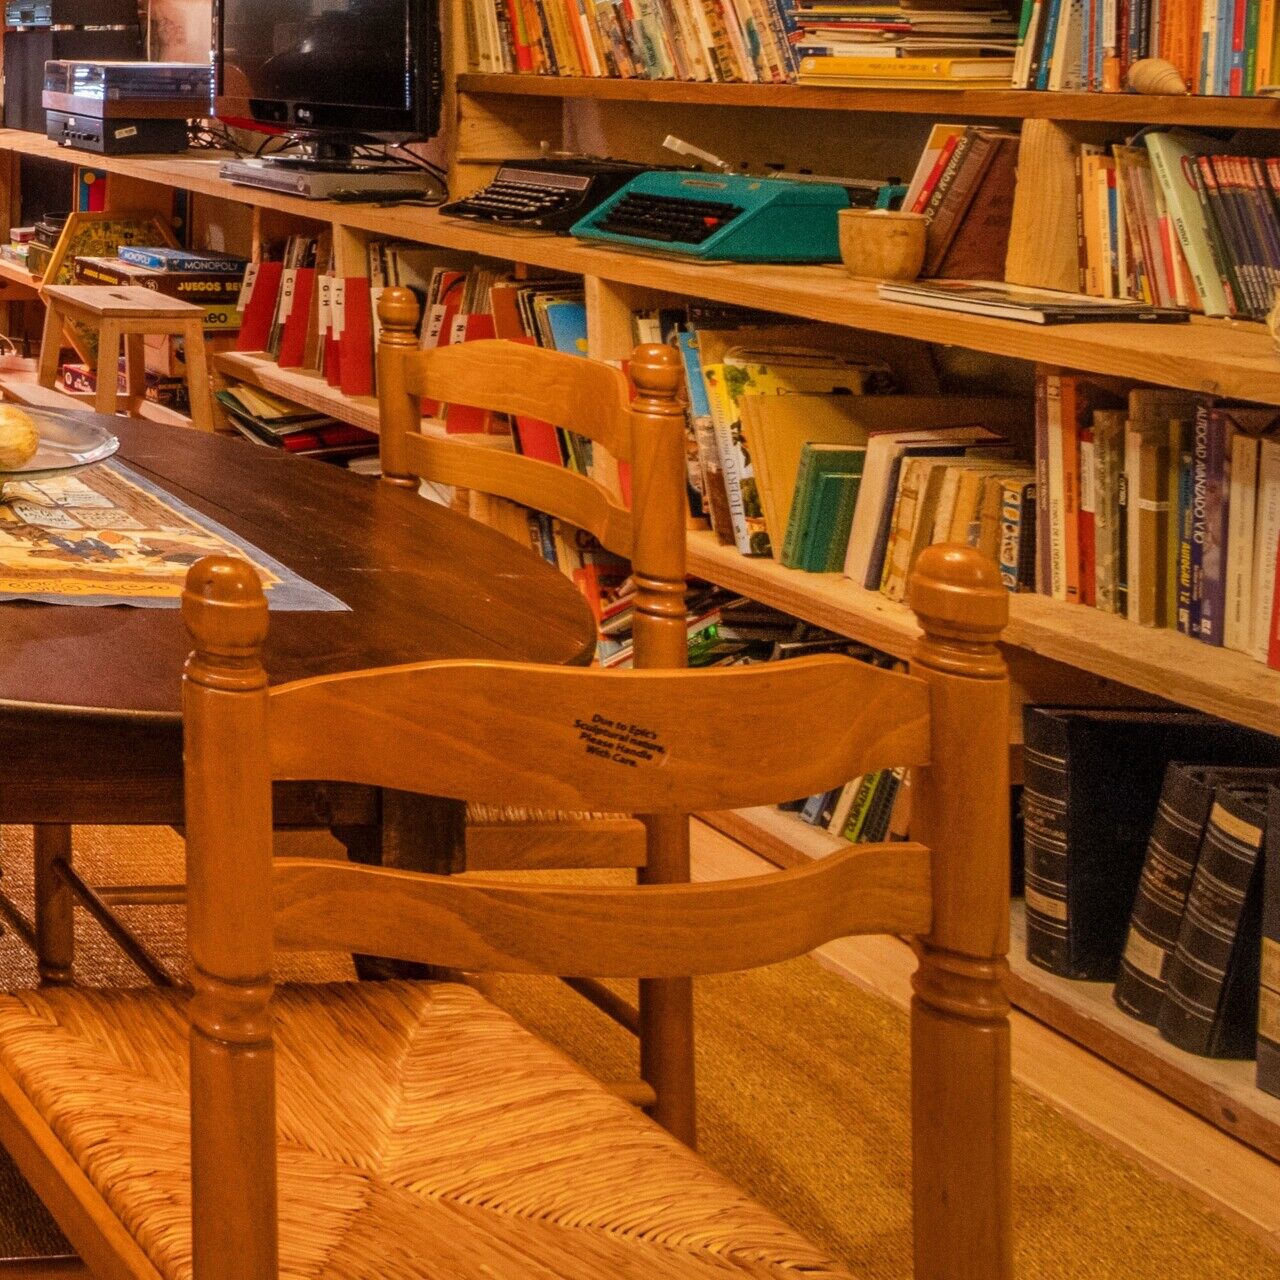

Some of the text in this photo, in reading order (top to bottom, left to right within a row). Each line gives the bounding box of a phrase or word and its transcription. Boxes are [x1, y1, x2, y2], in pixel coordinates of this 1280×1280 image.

[184, 260, 238, 272] MONOPOLY
[178, 281, 221, 293] JUEGOS
[1195, 406, 1208, 459] AUTOCAD
[725, 457, 744, 519] HUERTO
